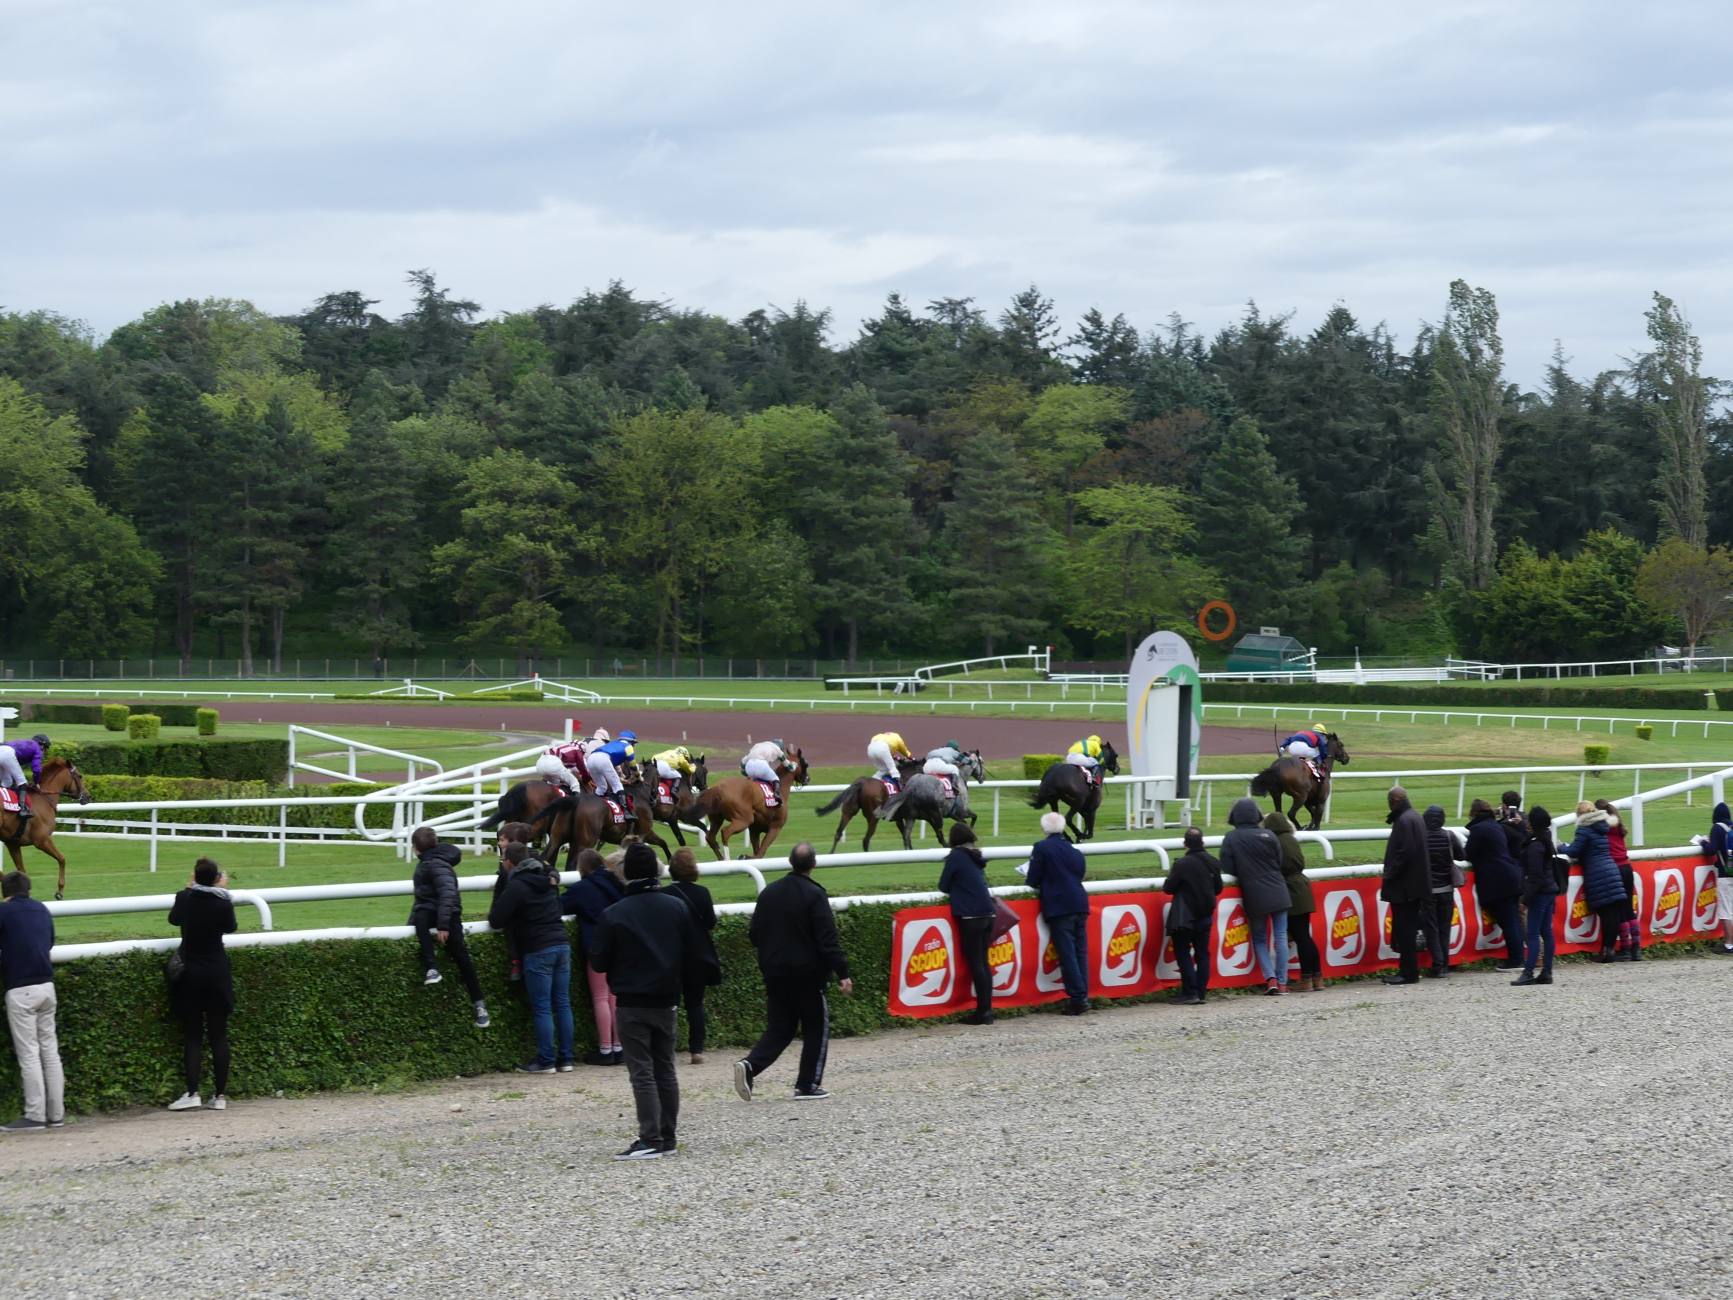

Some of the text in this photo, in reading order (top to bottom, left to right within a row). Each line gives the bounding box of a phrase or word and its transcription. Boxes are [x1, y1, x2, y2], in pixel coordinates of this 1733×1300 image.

[1333, 915, 1359, 938] SCOOP
[924, 939, 941, 951] radio
[988, 942, 1014, 966] COOP
[1109, 932, 1140, 956] SCOOP
[909, 948, 947, 974] SCOOP
